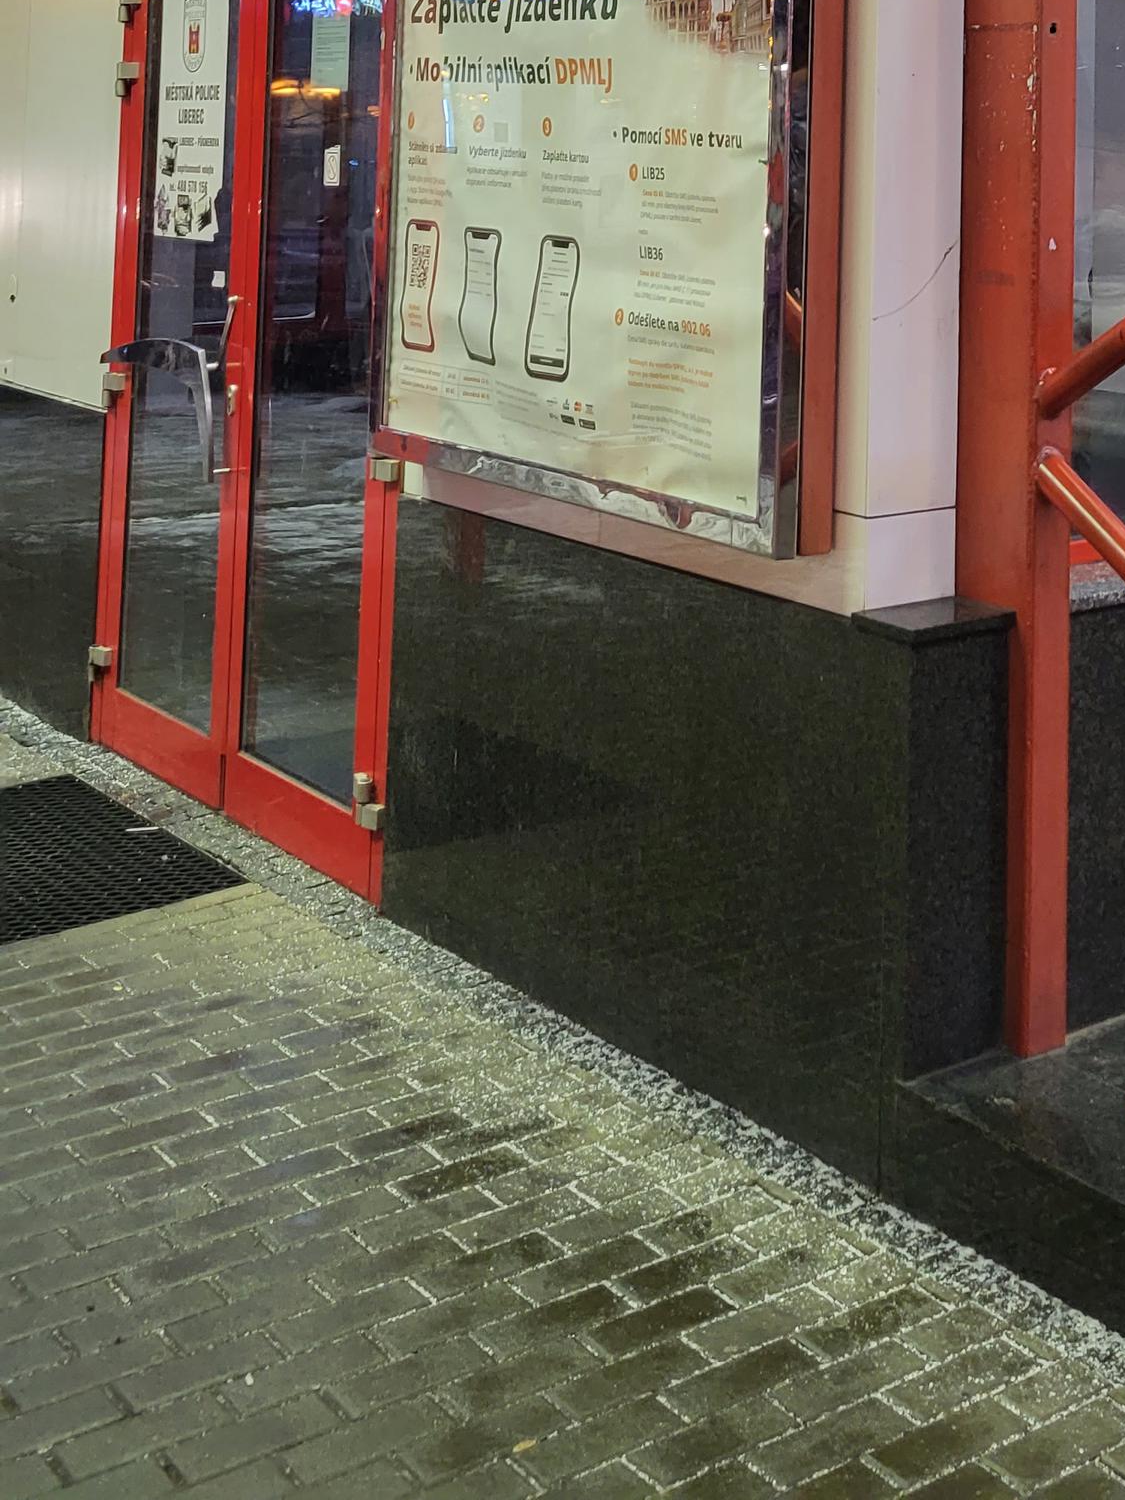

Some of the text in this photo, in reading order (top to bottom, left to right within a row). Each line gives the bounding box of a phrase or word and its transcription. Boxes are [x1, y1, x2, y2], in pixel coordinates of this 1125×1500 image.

[416, 56, 612, 94] Mobilní aplikací DPMLJ
[165, 81, 220, 101] MĚSTSKÁ POLICIE
[178, 108, 204, 125] LIBEREC
[622, 126, 742, 149] Pomocí SMS ve tvaru
[469, 145, 499, 159] Vyberte
[569, 150, 590, 164] kartou
[642, 166, 665, 181] LIB25
[639, 245, 664, 261] LIB36
[628, 311, 666, 330] Odešlete
[668, 320, 680, 332] na
[681, 319, 698, 335] 902
[700, 322, 711, 338] 06
